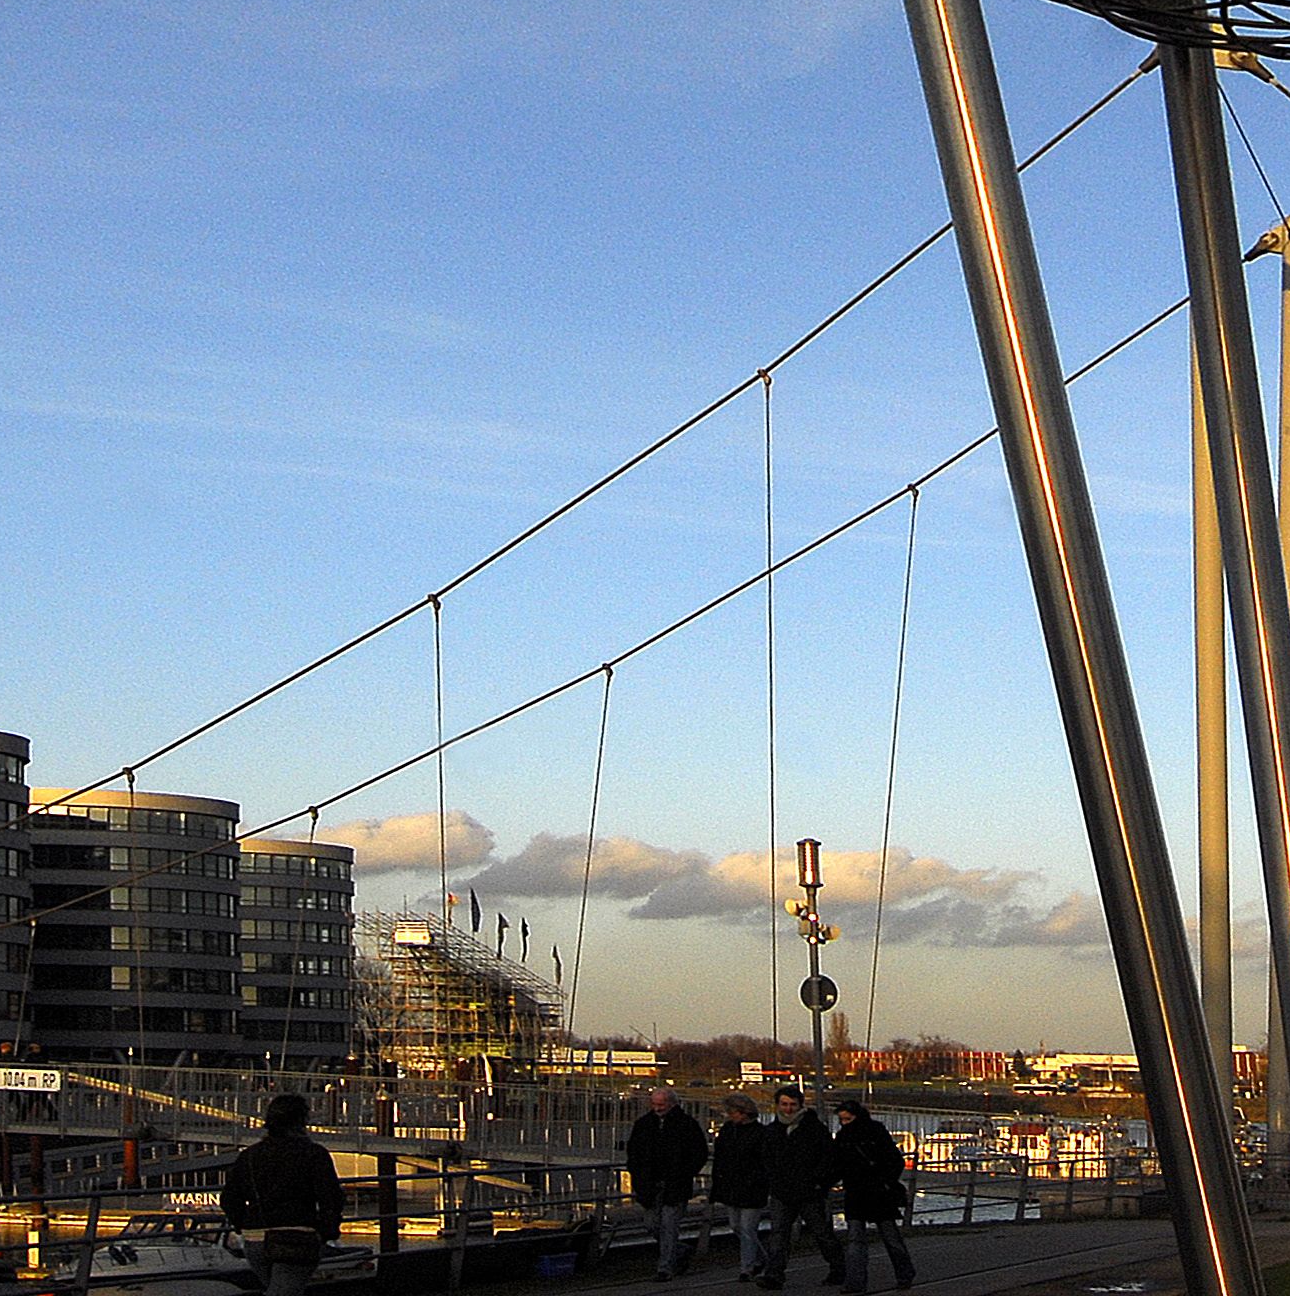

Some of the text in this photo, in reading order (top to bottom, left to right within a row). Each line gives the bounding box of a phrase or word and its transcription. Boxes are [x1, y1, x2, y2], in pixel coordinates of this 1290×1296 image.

[28, 1076, 37, 1087] m
[42, 1073, 56, 1088] RP
[170, 1192, 221, 1206] MARIN
